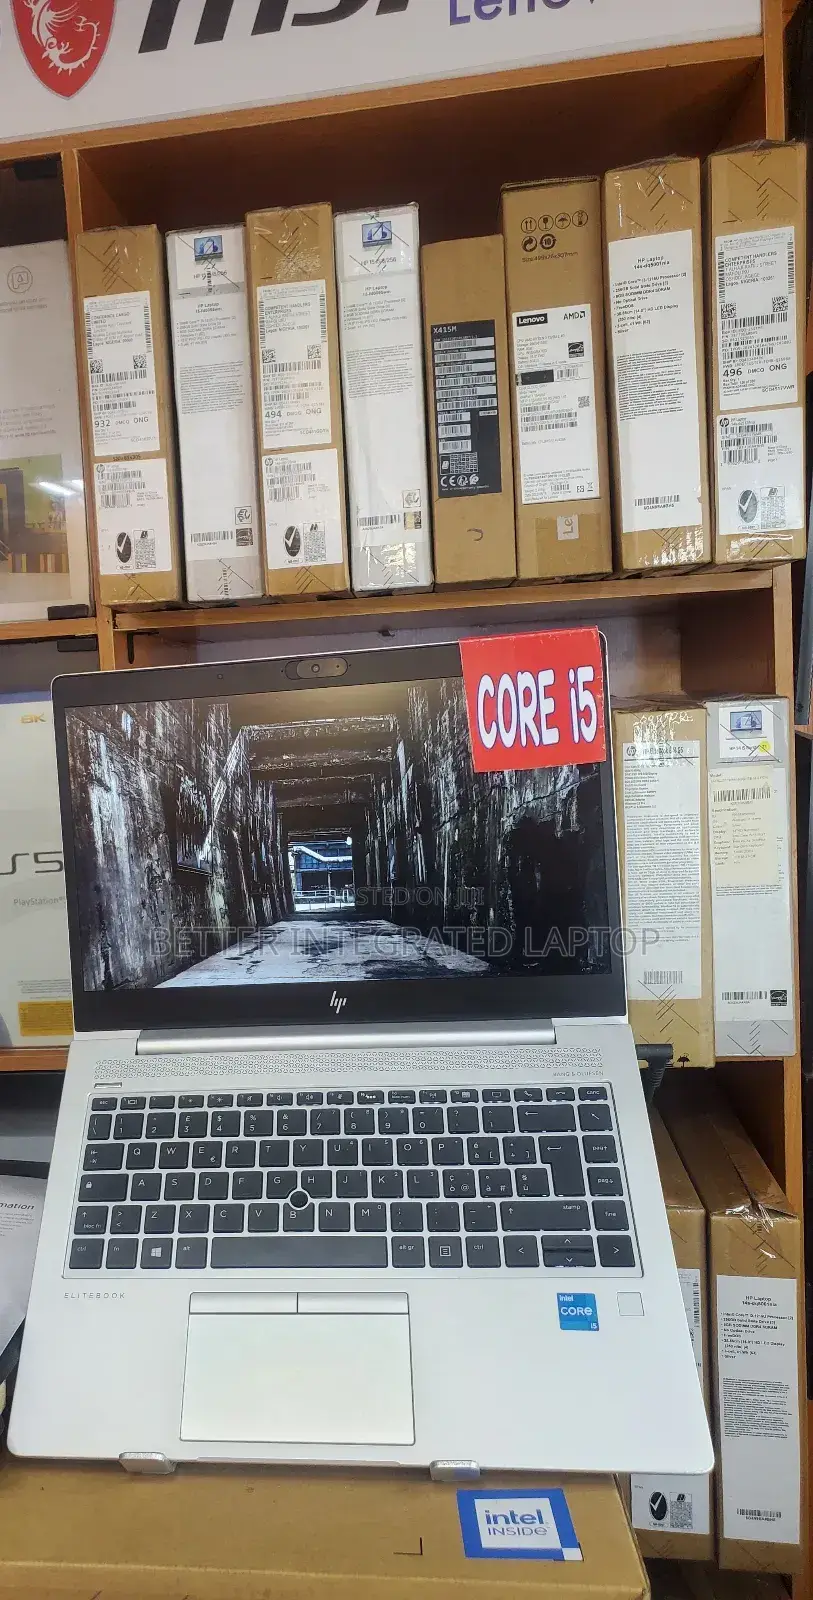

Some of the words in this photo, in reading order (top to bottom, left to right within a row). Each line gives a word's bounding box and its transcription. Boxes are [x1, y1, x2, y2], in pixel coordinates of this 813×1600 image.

[518, 315, 545, 324] Lenovo
[563, 312, 579, 320] AMD
[433, 326, 457, 334] X415M
[723, 368, 742, 377] 496
[769, 363, 787, 371] ONG
[265, 410, 282, 418] 494
[95, 420, 111, 428] 932
[477, 669, 560, 749] CORE
[568, 665, 598, 744] i5
[21, 713, 47, 724] 8K
[330, 991, 347, 1014] hp
[134, 1148, 141, 1156] Q
[485, 1508, 544, 1525] intel
